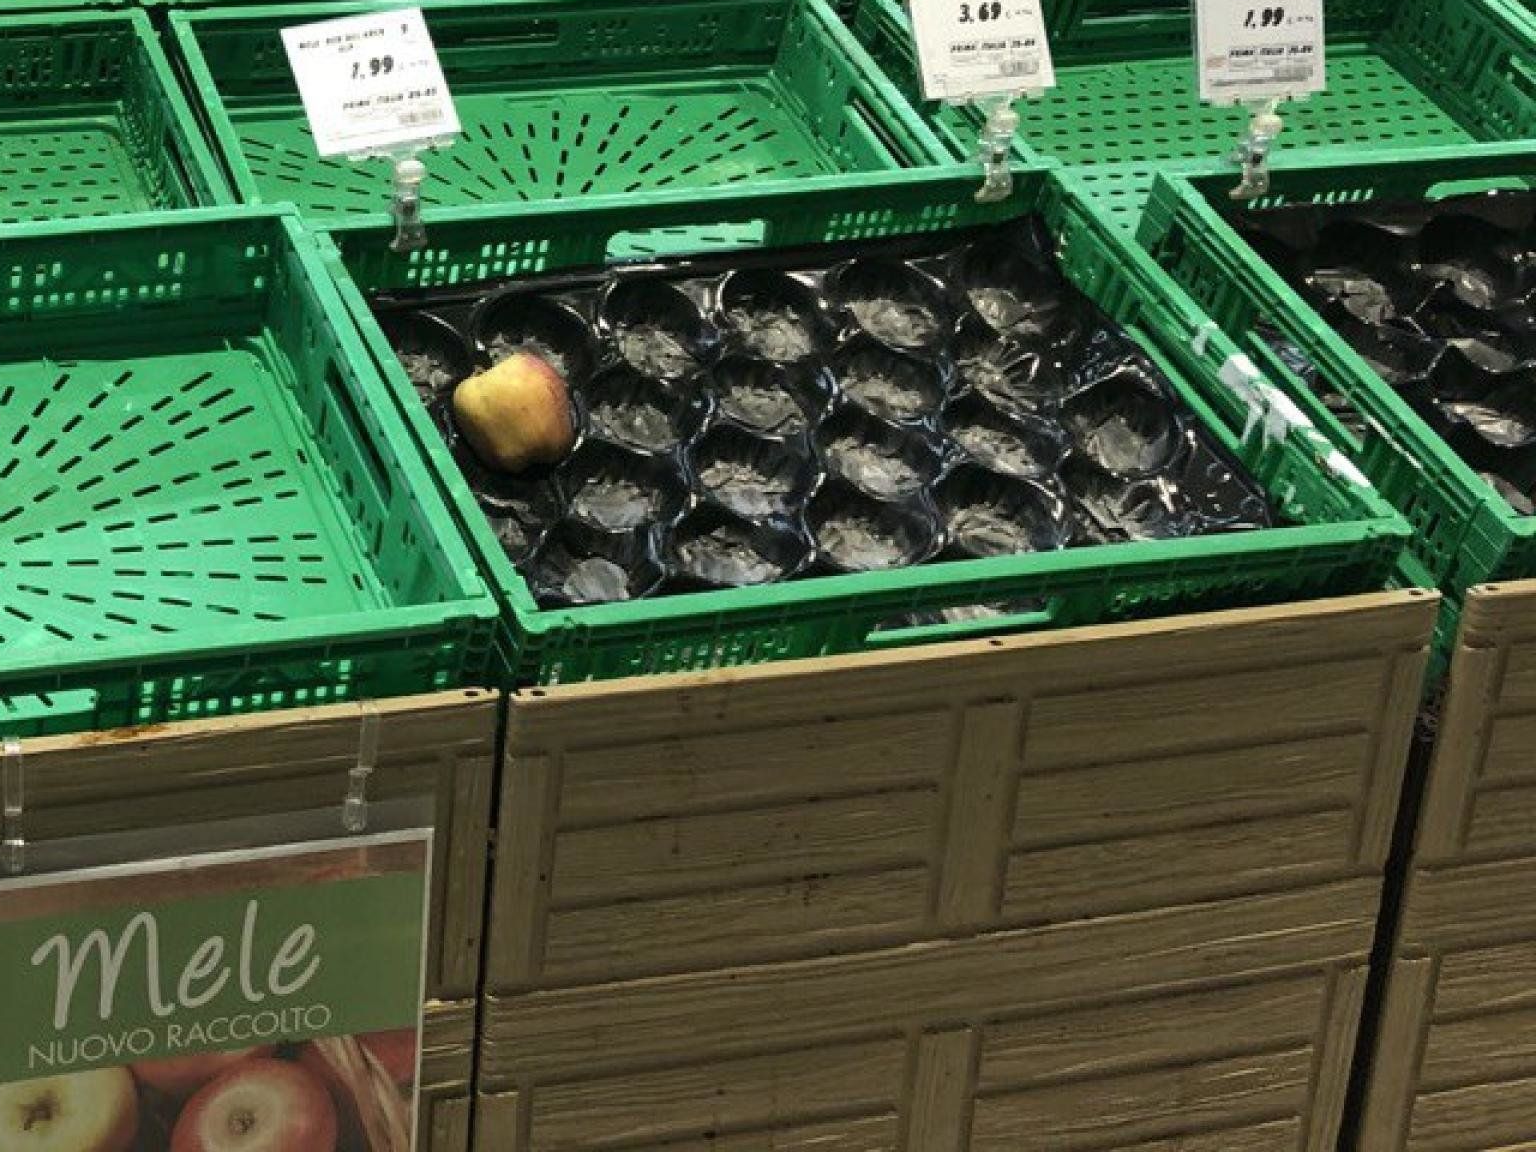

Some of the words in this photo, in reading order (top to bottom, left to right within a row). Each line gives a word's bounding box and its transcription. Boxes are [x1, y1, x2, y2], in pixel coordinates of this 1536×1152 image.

[30, 899, 322, 1031] Mele
[28, 1028, 154, 1070] NUOVO
[166, 1004, 332, 1050] RACCOLTO
